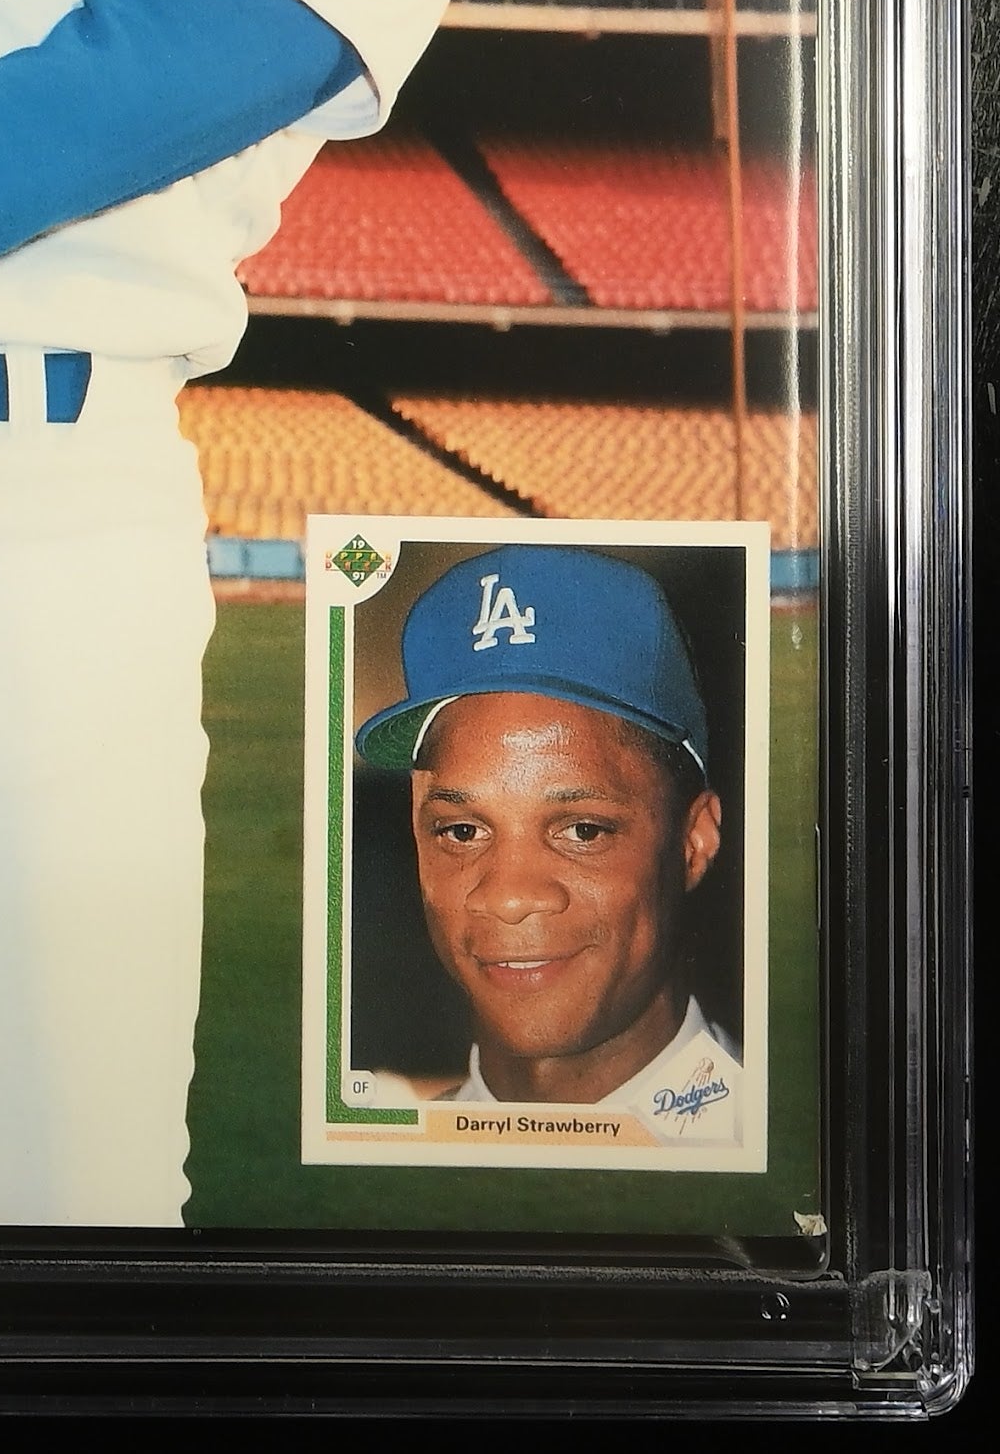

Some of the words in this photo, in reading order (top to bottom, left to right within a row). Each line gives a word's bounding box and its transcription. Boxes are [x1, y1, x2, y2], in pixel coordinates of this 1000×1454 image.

[352, 540, 366, 550] 19
[352, 572, 366, 581] 91
[473, 574, 536, 652] LA
[353, 1082, 369, 1094] OF
[653, 1077, 730, 1116] Dodgers
[456, 1116, 511, 1136] Darryl
[517, 1117, 621, 1137] Strawberry
